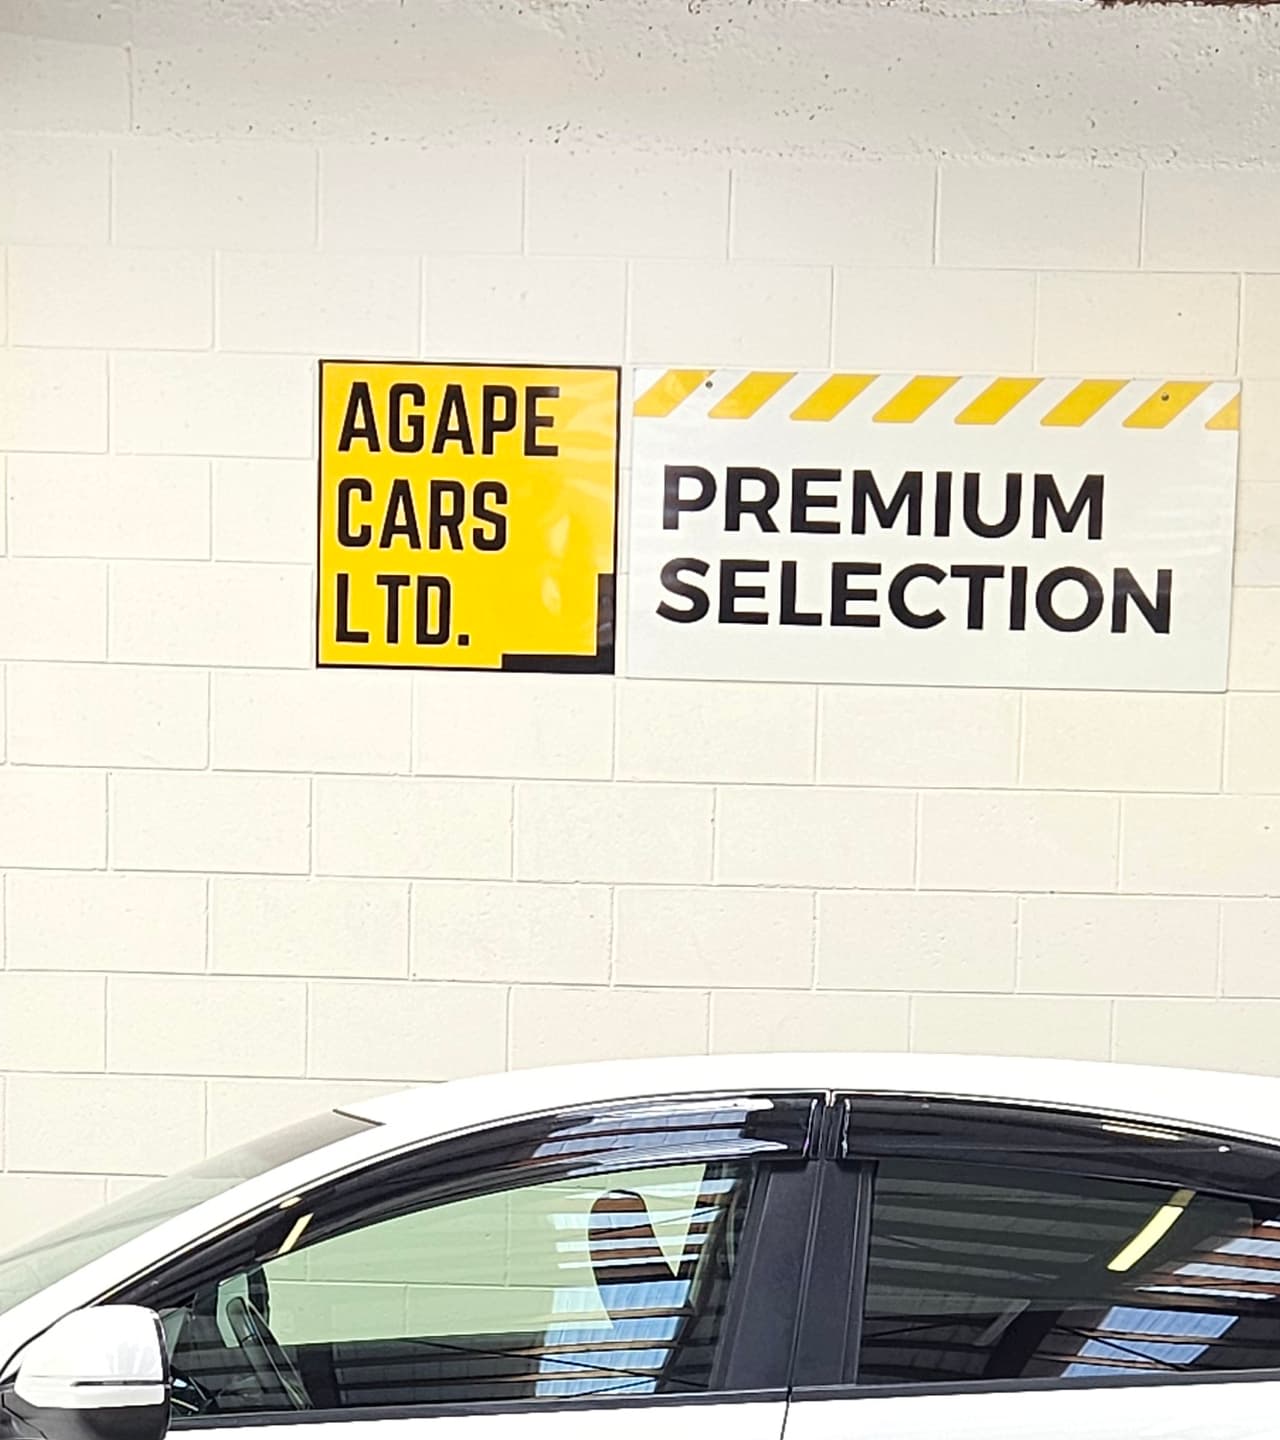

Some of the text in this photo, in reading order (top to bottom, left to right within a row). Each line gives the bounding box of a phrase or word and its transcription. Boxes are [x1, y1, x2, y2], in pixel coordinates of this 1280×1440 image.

[337, 381, 560, 458] AGAPE
[336, 478, 509, 552] CARS
[662, 464, 1106, 541] PREMIUM
[334, 573, 471, 647] LTD.
[655, 557, 1174, 635] SELECTION
